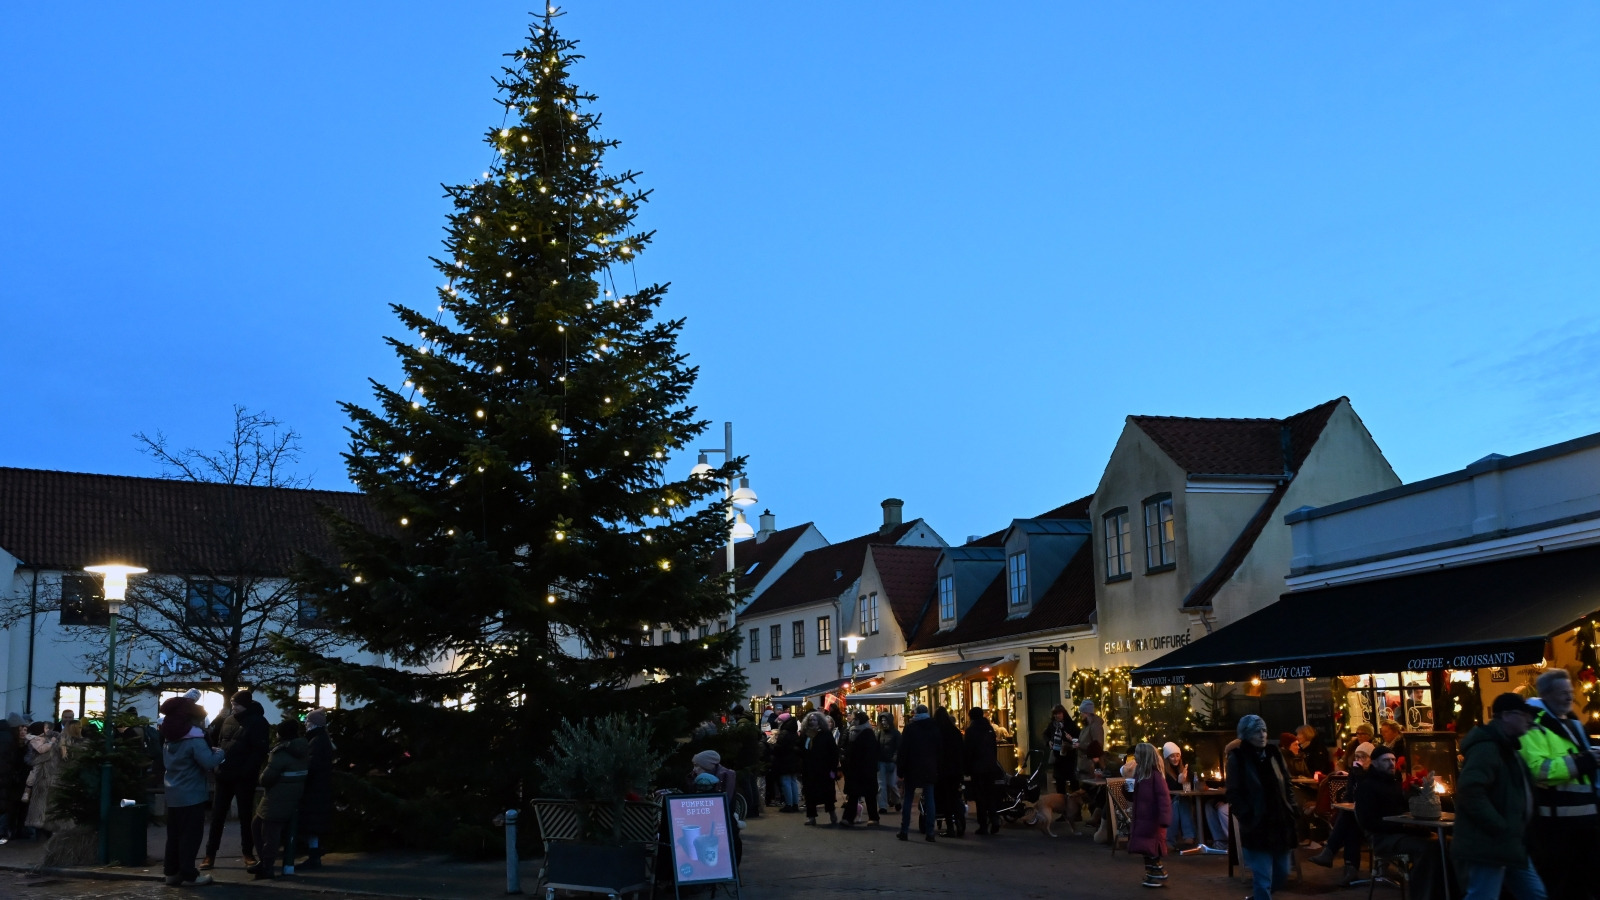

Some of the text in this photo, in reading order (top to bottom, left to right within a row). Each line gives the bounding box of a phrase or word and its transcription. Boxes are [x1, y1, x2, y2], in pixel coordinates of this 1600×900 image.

[1407, 652, 1515, 670] COFFEE CROISSANTS
[1290, 665, 1312, 679] CAFE
[681, 800, 714, 808] PUMPKIN
[686, 808, 711, 816] SPICE
